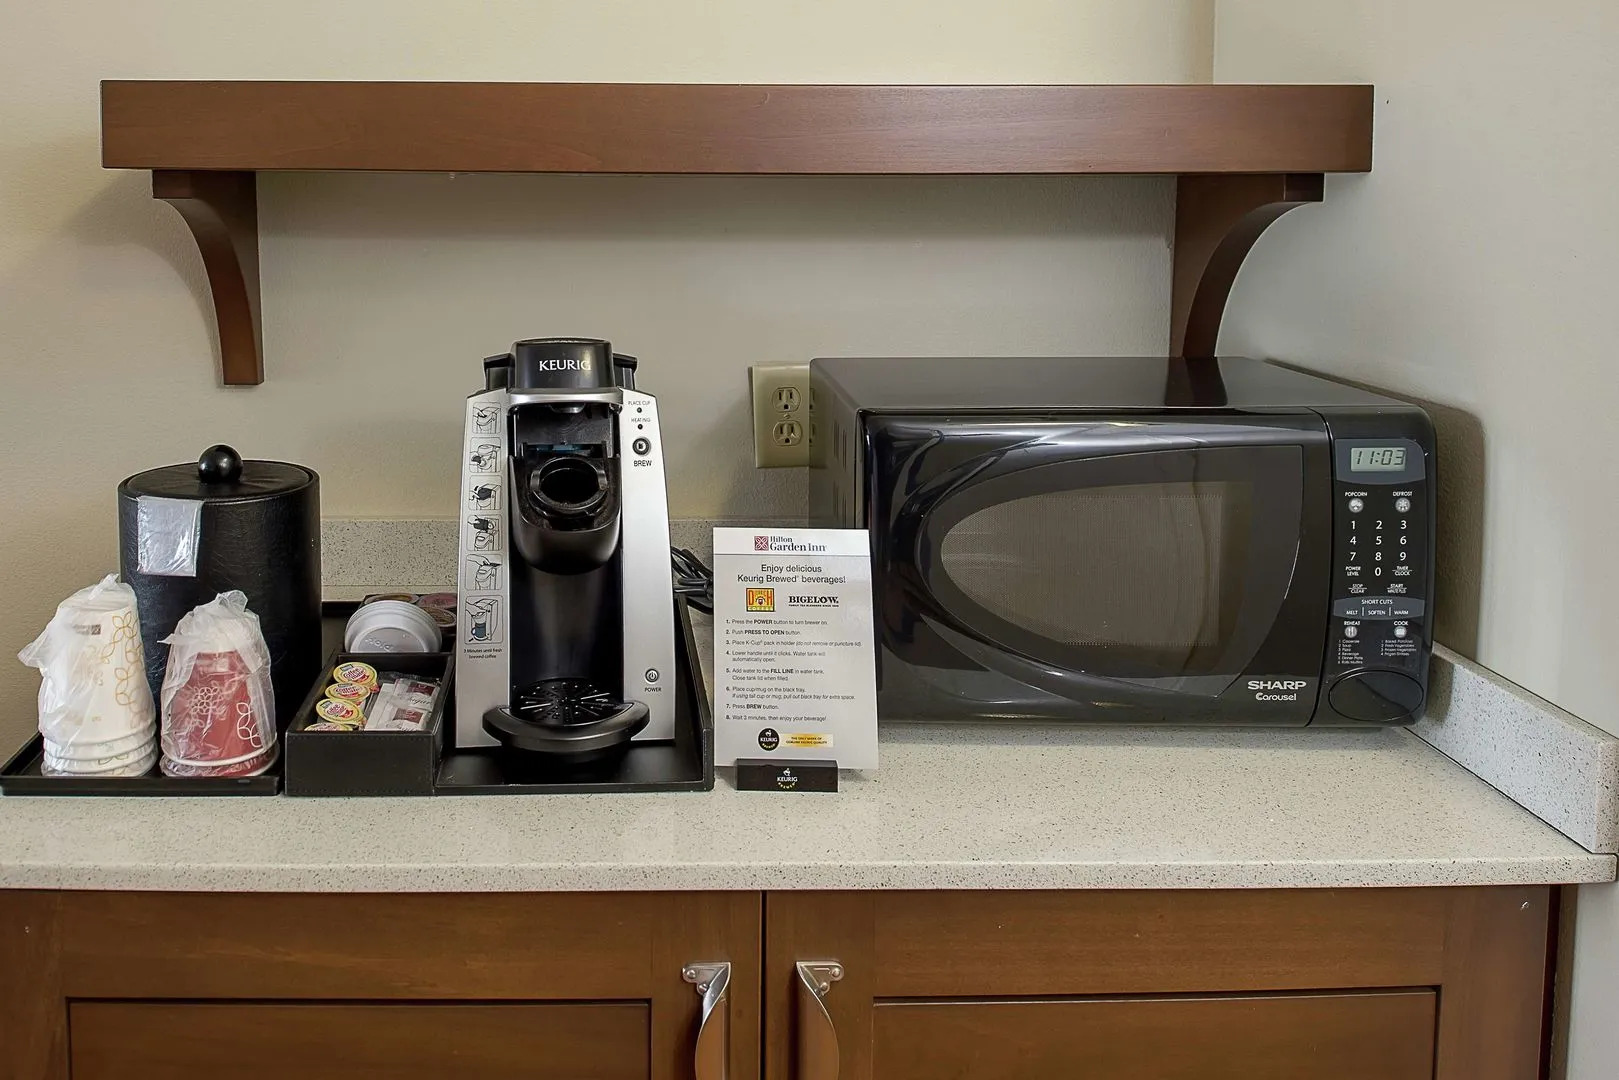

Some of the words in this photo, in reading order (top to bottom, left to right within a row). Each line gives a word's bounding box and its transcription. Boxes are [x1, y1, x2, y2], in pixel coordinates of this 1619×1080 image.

[538, 360, 592, 372] KEURIG
[1356, 450, 1406, 465] 11:03
[1351, 521, 1356, 529] 1
[1376, 521, 1382, 529] 2
[1400, 521, 1407, 529] 3
[1350, 536, 1357, 545] 4
[1376, 536, 1382, 545] 5
[1400, 536, 1407, 545] 6
[770, 543, 806, 551] Garden
[808, 543, 826, 551] Inn
[1350, 552, 1356, 561] 7
[1375, 552, 1382, 561] 8
[1400, 552, 1406, 561] 9
[761, 564, 784, 574] Enjoy
[1375, 567, 1382, 576] 0
[737, 575, 764, 584] Keurig
[802, 575, 846, 585] beverages!
[1248, 681, 1306, 690] SHARP
[1256, 692, 1297, 701] Carousel
